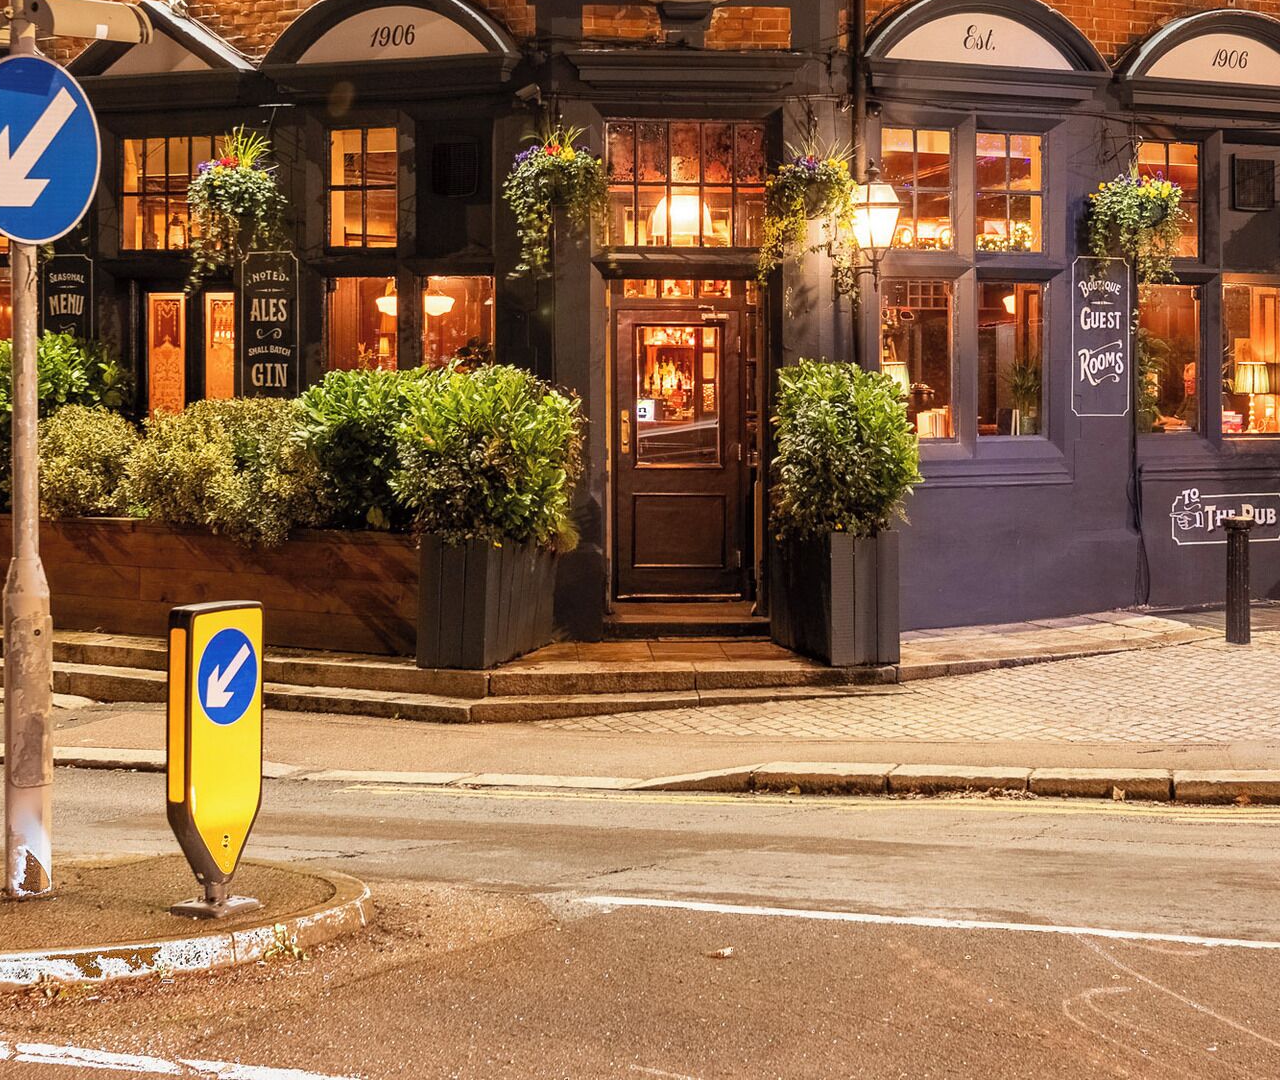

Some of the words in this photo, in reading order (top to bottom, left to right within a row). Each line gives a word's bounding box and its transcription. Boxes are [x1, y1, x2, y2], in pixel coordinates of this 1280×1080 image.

[370, 23, 416, 48] 1906
[963, 24, 996, 51] Est.
[1212, 48, 1249, 70] 1906
[49, 272, 85, 284] SEASONAL
[252, 270, 286, 283] NOTED
[49, 293, 85, 316] MENU
[250, 298, 288, 322] ALES
[1080, 306, 1122, 330] GUEST
[248, 346, 269, 357] SMALL
[269, 344, 291, 357] BATCH
[251, 362, 289, 388] GIN
[1078, 348, 1124, 386] ROOMS
[1182, 488, 1200, 504] TO
